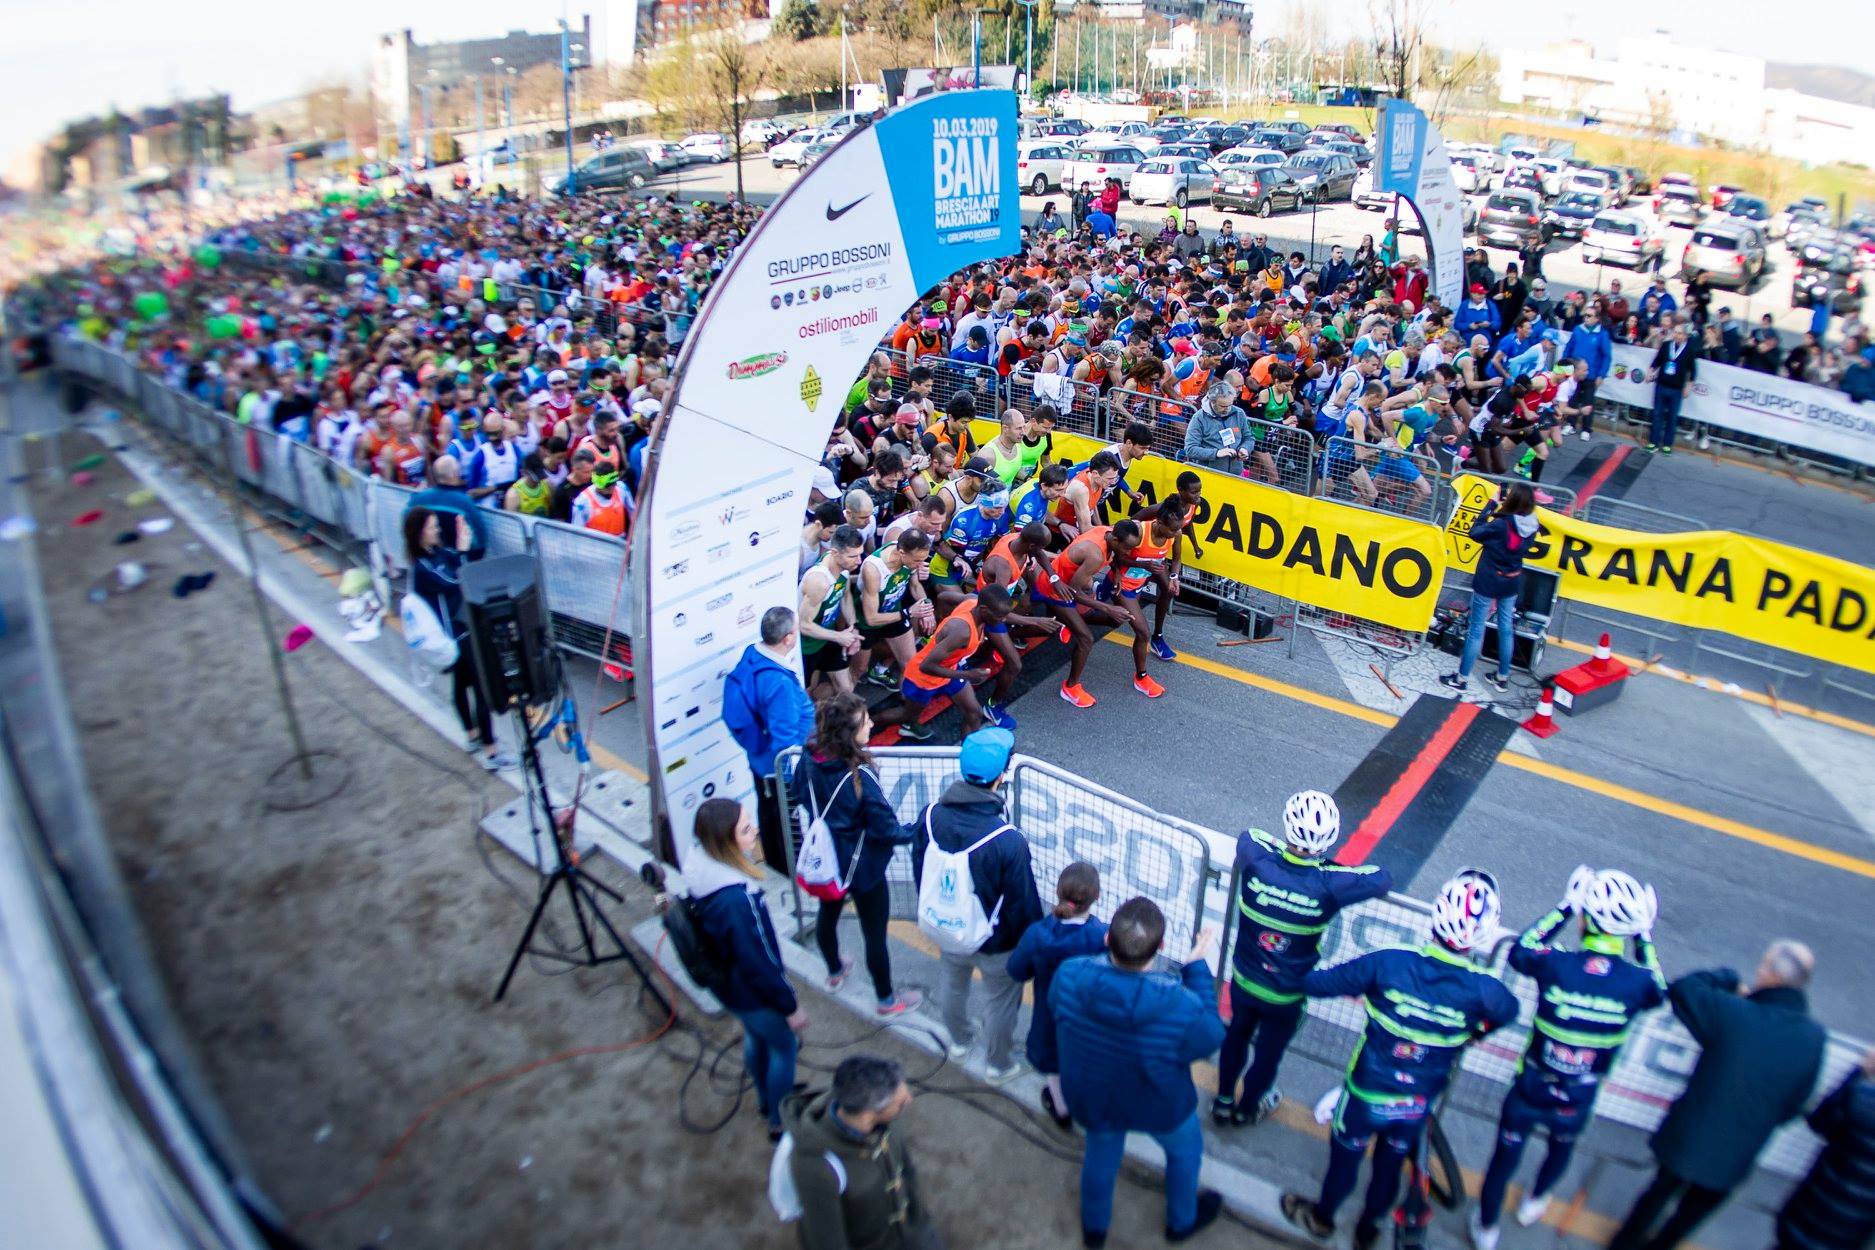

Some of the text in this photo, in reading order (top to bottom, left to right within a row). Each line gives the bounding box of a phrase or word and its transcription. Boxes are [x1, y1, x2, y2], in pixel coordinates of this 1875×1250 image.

[932, 117, 998, 138] 10.03.2019
[933, 137, 1000, 200] BAM
[935, 194, 1000, 215] BRESCIA ART
[768, 253, 829, 278] GRUPPO
[831, 242, 891, 266] BOSSONI
[799, 307, 878, 338] ostiliomobili
[1729, 385, 1805, 415] GRUPPO
